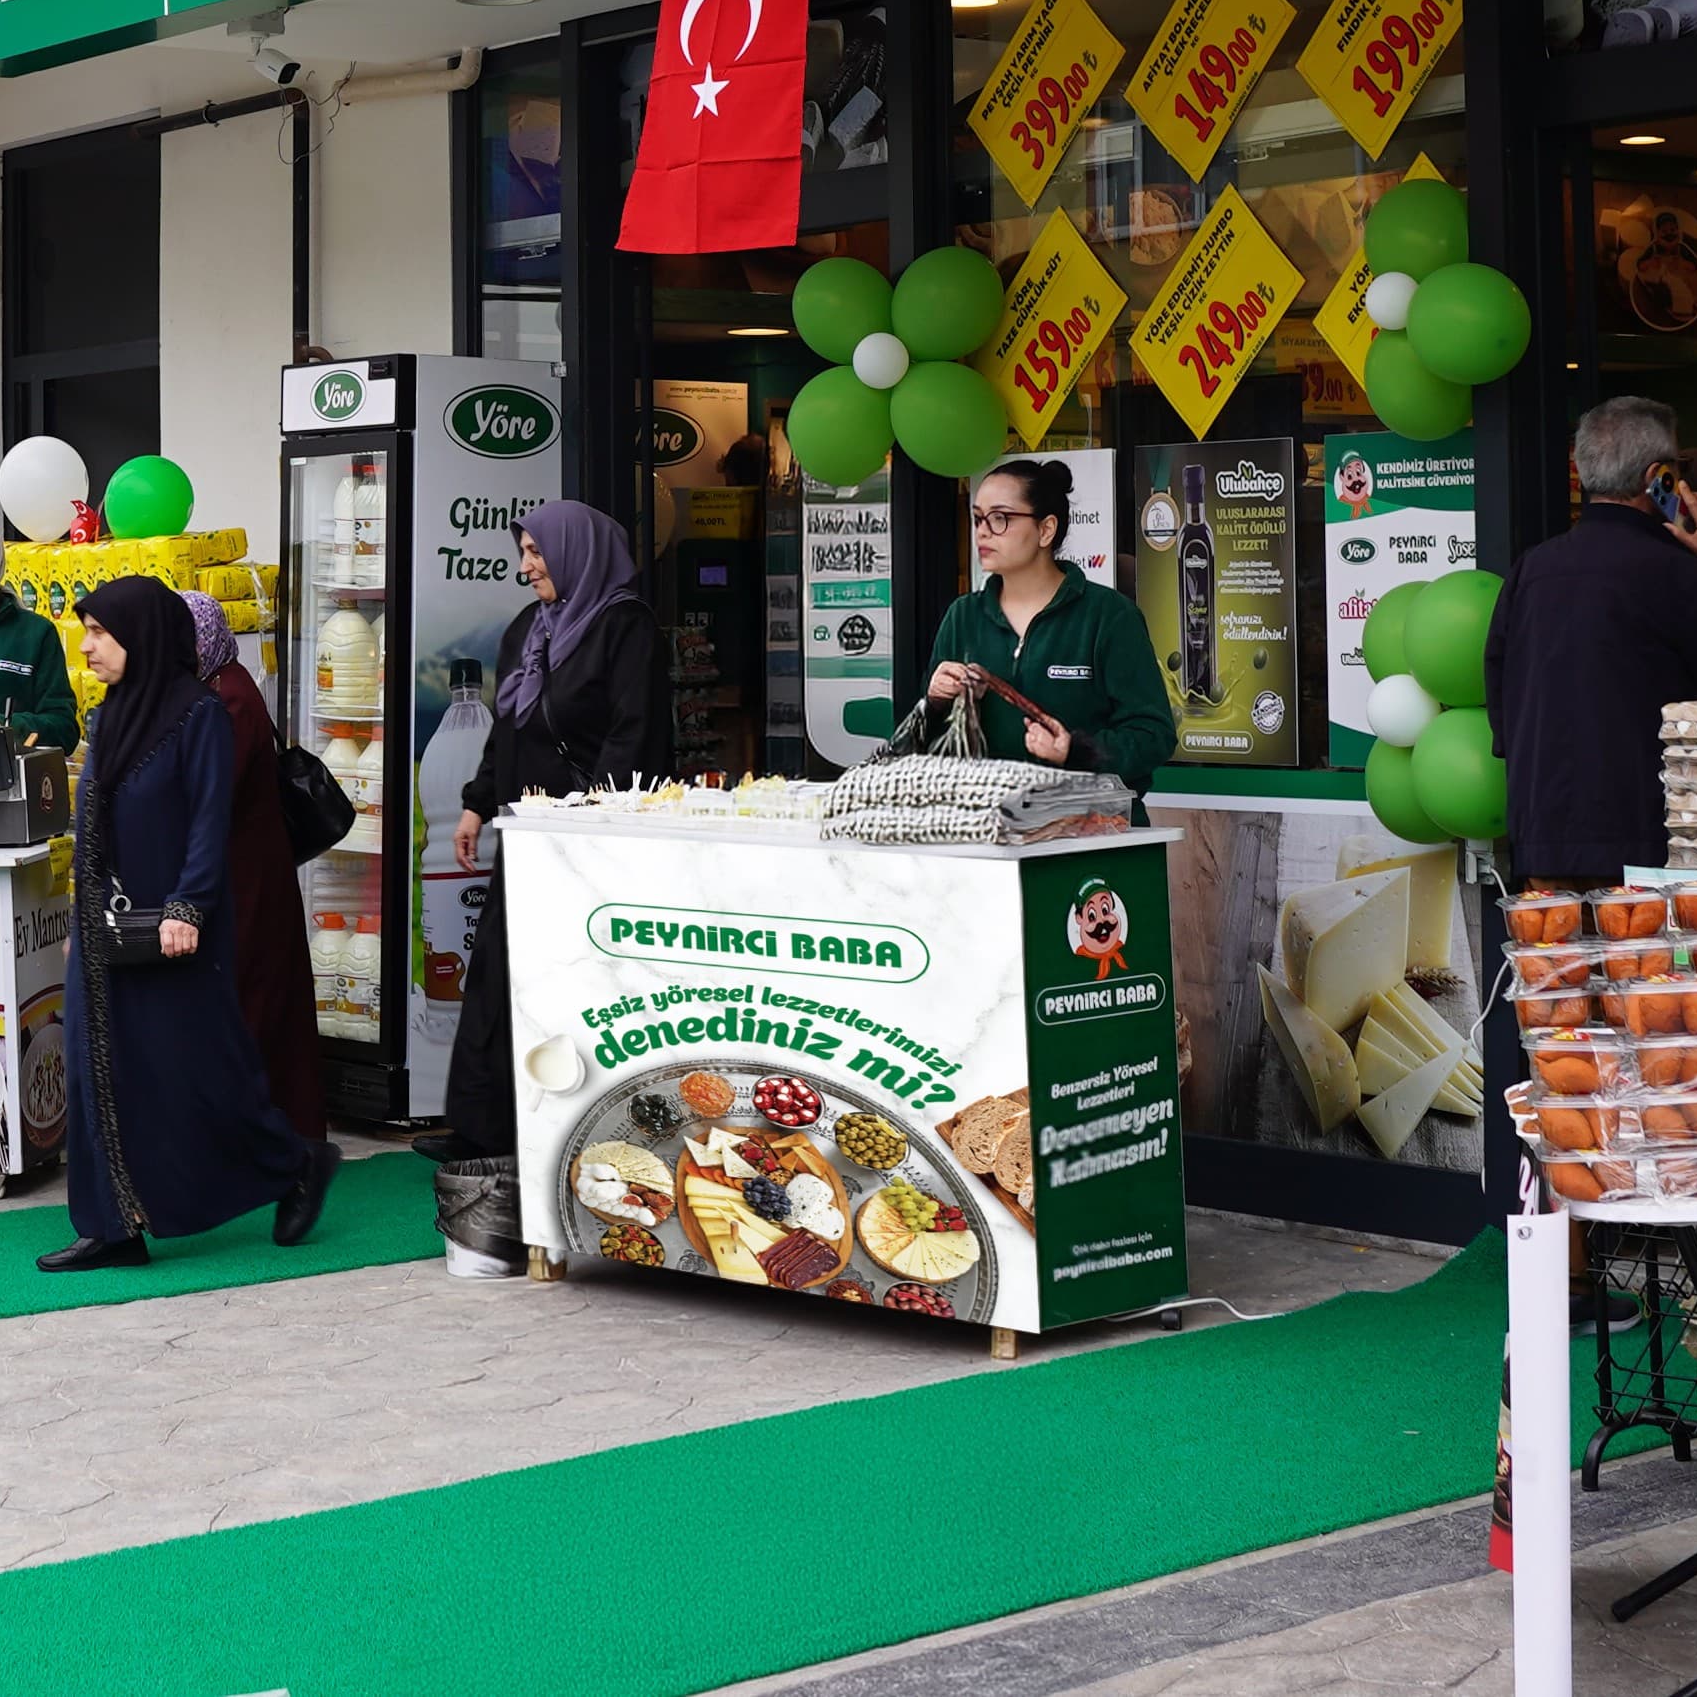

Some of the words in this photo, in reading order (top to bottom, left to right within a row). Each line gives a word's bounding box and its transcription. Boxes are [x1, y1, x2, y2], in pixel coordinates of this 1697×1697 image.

[1011, 27, 1037, 68] YARIM
[1023, 19, 1055, 74] PEYNİRİ
[1336, 5, 1370, 53] FINDIK
[1142, 44, 1171, 93] AFİTAT
[1168, 17, 1187, 45] BOL
[1164, 37, 1187, 76] ÇİLEK
[1175, 28, 1257, 143] 149.00
[1010, 63, 1089, 170] 399.00
[1010, 277, 1034, 313] YÖRE
[1144, 308, 1170, 345] YÖRE
[1168, 252, 1204, 309] EDREMİT
[1201, 208, 1233, 255] JUMBO
[1158, 311, 1184, 345] YEŞİL
[1183, 276, 1206, 311] ÇİZİK
[1203, 230, 1235, 278] ZEYTİN
[996, 326, 1018, 359] TAZE
[1016, 280, 1048, 328] GÜNLÜK
[1045, 252, 1062, 280] SÜT
[1015, 307, 1091, 413] 159.00
[1178, 291, 1266, 398] 249.00
[321, 381, 354, 412] Yöre
[469, 399, 536, 441] Yöre
[1219, 476, 1281, 497] Ulubahçe
[1377, 458, 1424, 475] KENDİMİZ
[1377, 476, 1425, 489] KALİTESİNE
[1216, 506, 1286, 519] ULUSLARARASI
[1217, 521, 1248, 535] KALİTE
[1250, 521, 1286, 534] ÖDÜLLÜ
[438, 547, 508, 582] Taze
[1233, 540, 1269, 551] LEZZET!
[1347, 543, 1370, 560] Yöre
[1398, 551, 1428, 564] BABA
[1224, 737, 1248, 748] BABA
[610, 918, 778, 958] PEYNİRCİ
[791, 933, 902, 968] BABA
[1045, 990, 1111, 1015] PEYNİRCİ
[1116, 984, 1156, 1006] BABA
[581, 995, 646, 1029] Eşsiz
[652, 984, 754, 1012] yöresel
[761, 986, 963, 1078] lezzetlerimizi
[594, 1007, 843, 1070] denediniz
[846, 1048, 956, 1110] mi?
[1051, 1071, 1110, 1099] Benzersiz
[1113, 1056, 1158, 1082] Yöresel
[1077, 1081, 1135, 1110] Lezzetleri
